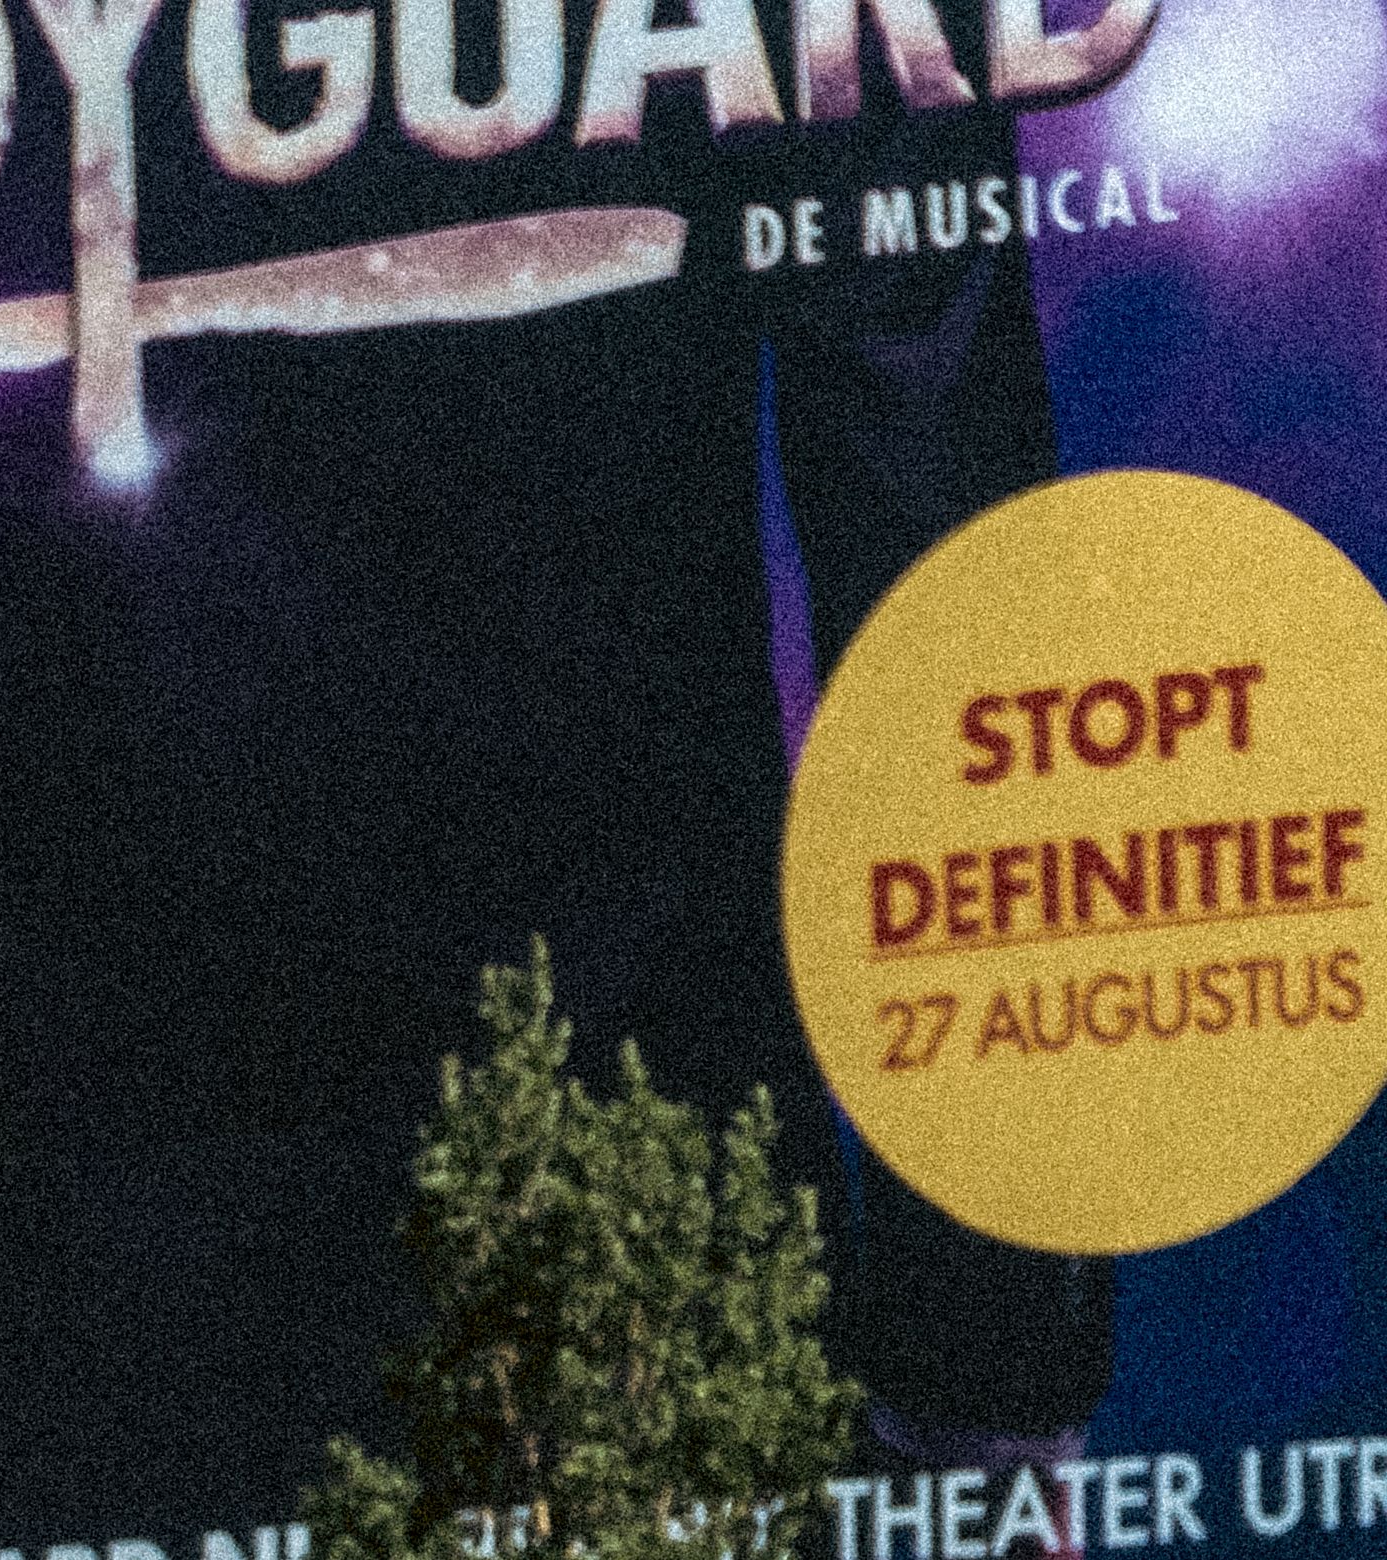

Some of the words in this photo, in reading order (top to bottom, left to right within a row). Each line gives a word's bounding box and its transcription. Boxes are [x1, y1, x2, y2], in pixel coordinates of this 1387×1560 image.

[743, 201, 827, 273] DE
[863, 165, 1178, 259] MUSICAL
[959, 663, 1265, 785] STOPT
[869, 808, 1368, 948] DEFINITIEF
[877, 996, 959, 1072] 27
[975, 950, 1367, 1060] AUGUSTUS
